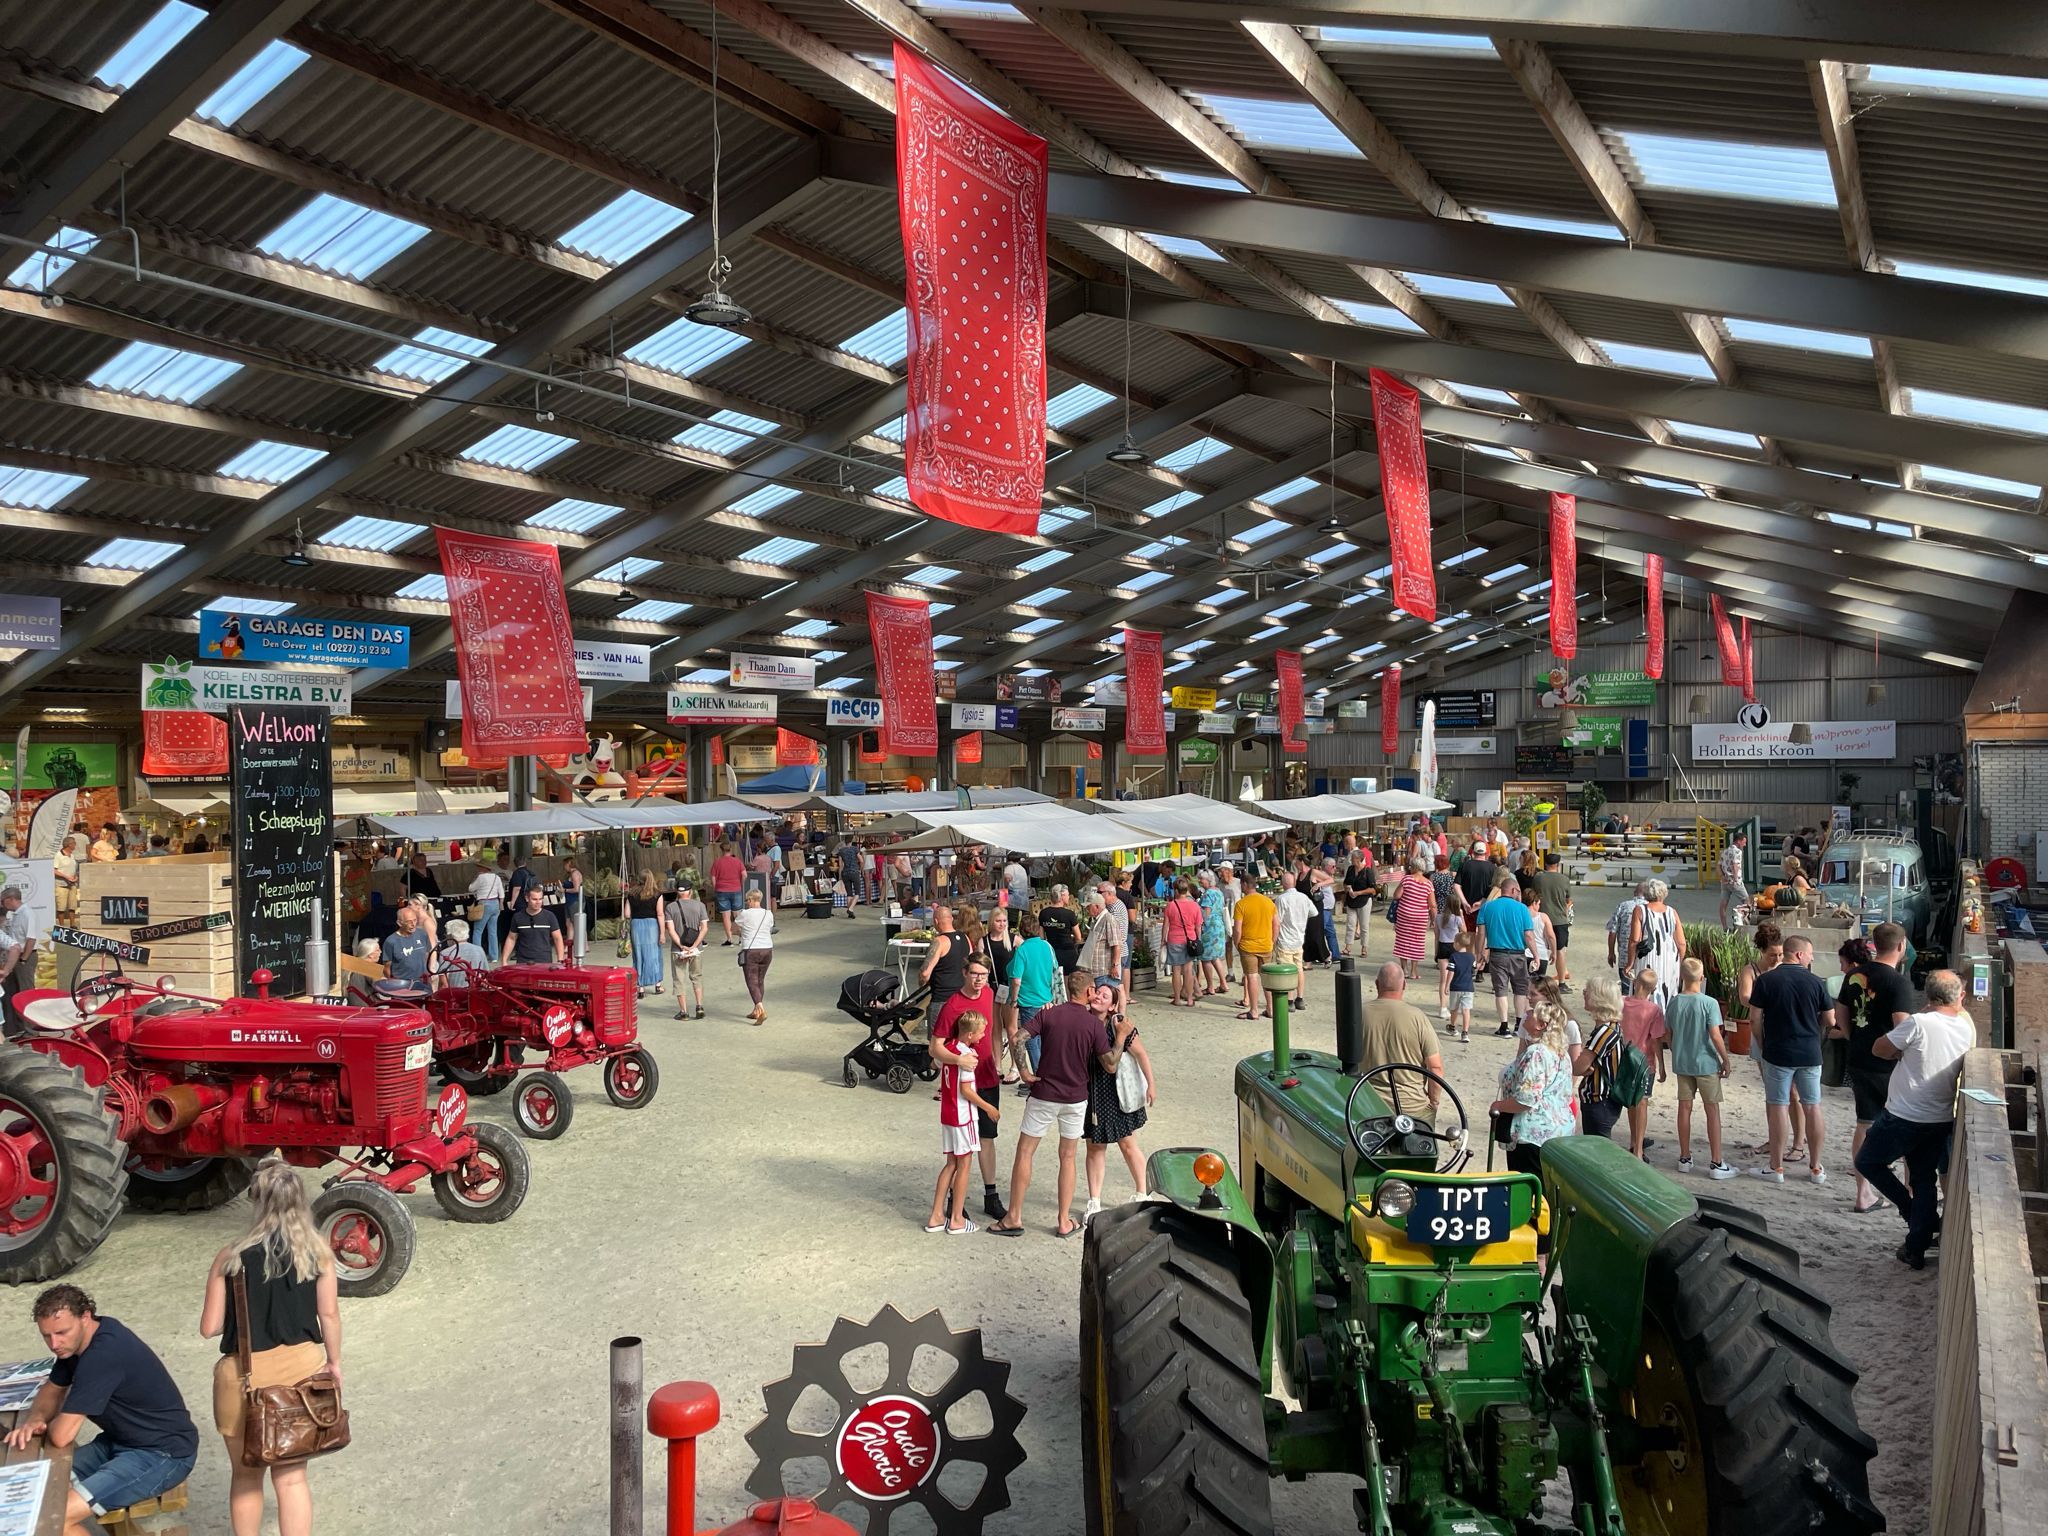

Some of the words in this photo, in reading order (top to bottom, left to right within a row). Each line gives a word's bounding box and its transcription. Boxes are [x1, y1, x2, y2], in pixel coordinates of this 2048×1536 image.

[249, 618, 325, 638] GARAGE
[332, 624, 365, 641] DEN
[372, 628, 404, 644] DAS
[263, 639, 280, 648] Den
[282, 639, 308, 650] Oever
[327, 643, 357, 654] (0227)
[359, 646, 368, 654] 51
[370, 646, 380, 655] 23
[288, 653, 369, 664] www.garagedendas.nl
[573, 651, 594, 661] RIES
[603, 653, 622, 663] VAN
[625, 654, 643, 665] HAL
[749, 660, 776, 673] Thaam
[778, 662, 796, 674] Dam
[203, 670, 238, 681] KOEL-
[242, 672, 257, 682] EN
[261, 673, 348, 686] SORTEERBEDRIJF
[146, 689, 199, 709] KSK
[203, 683, 303, 701] KIELSTRA
[311, 688, 347, 702] B.V.
[672, 696, 683, 709] D.
[686, 697, 726, 710] SCHENK
[728, 699, 769, 711] Makelaardij
[831, 699, 880, 719] neCap
[961, 707, 979, 723] Fysio
[1719, 734, 1791, 743] Paardenklinie
[1866, 723, 1894, 736] your
[1698, 745, 1764, 757] Hollands
[1769, 745, 1815, 757] Kroon
[379, 758, 398, 775] .nl
[244, 785, 271, 800] Zaterdag
[246, 863, 272, 879] Zondag
[258, 877, 316, 900] Meezingkoor
[104, 899, 137, 920] JAM
[262, 897, 313, 919] WIERINGE
[58, 927, 68, 942] DE
[131, 929, 160, 943] STRO
[161, 917, 203, 937] DOOLHOF
[546, 1009, 567, 1028] Oude
[244, 1034, 302, 1043] FARMALL
[549, 1022, 571, 1044] Glorie
[321, 1043, 332, 1055] M
[440, 1088, 461, 1117] Oude
[442, 1100, 465, 1136] Glorie
[1438, 1187, 1489, 1212] TPT
[1430, 1217, 1491, 1242] 93-B
[883, 1410, 929, 1468] Oude
[846, 1421, 902, 1488] Glorie
